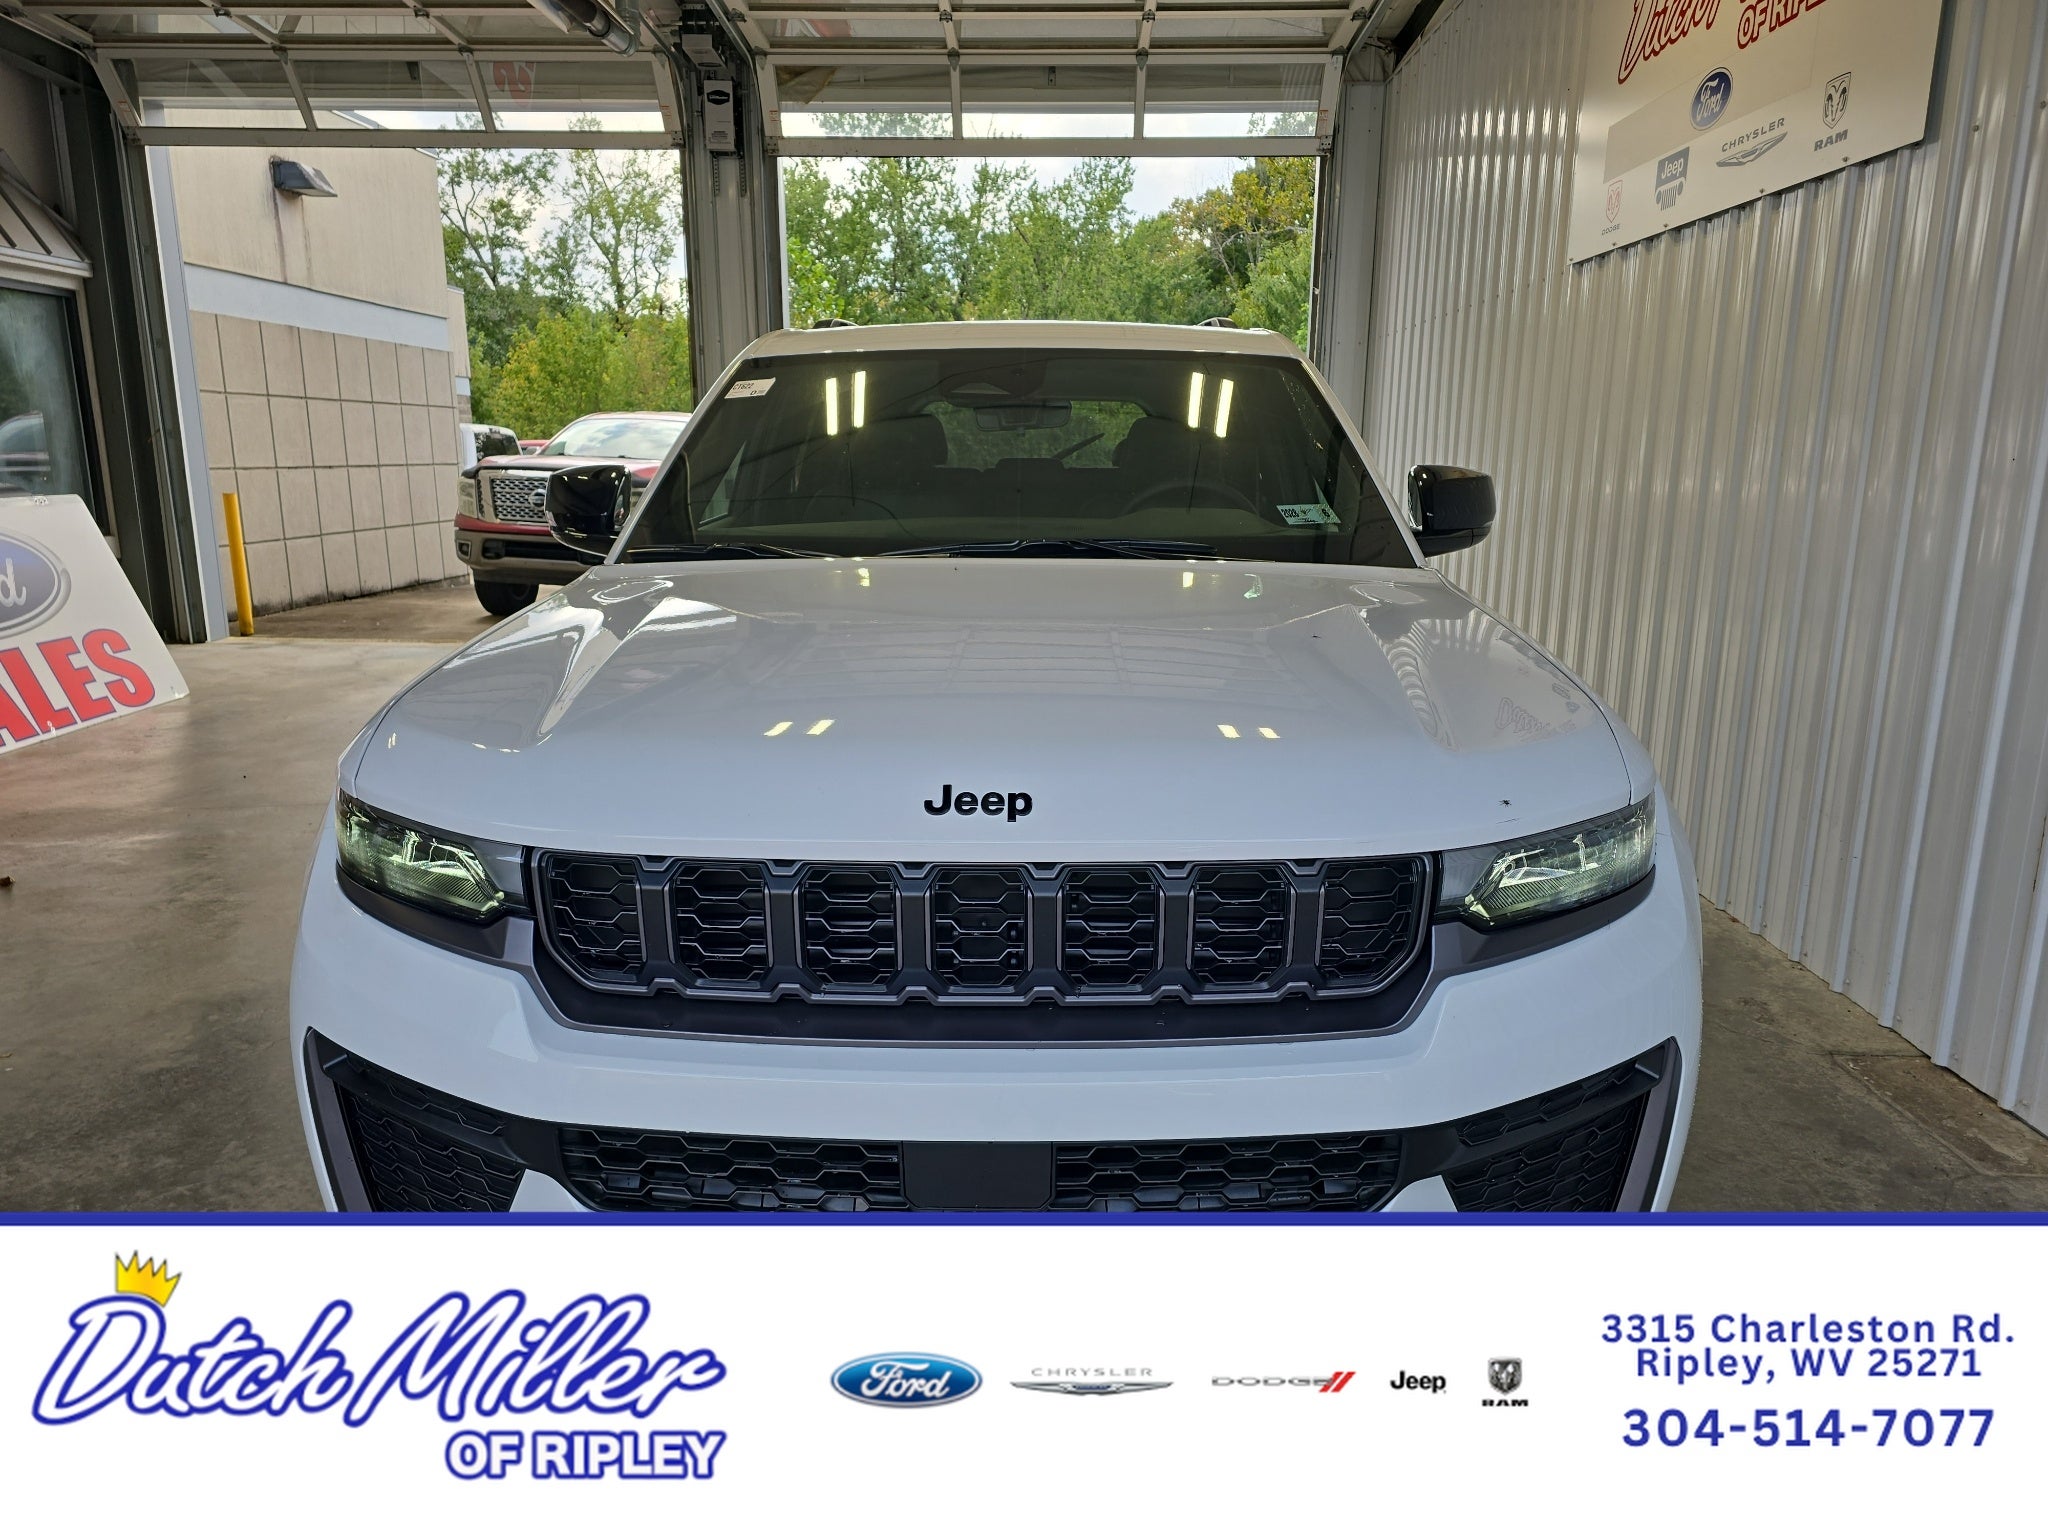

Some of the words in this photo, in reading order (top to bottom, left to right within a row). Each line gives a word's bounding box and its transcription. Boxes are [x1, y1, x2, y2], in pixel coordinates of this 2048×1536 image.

[1737, 0, 1768, 49] OF
[1721, 117, 1785, 153] CHRYSLER
[1814, 129, 1849, 152] RAM
[1660, 156, 1685, 179] Jeep
[1601, 223, 1621, 236] DODGE
[923, 783, 1033, 822] Jeep
